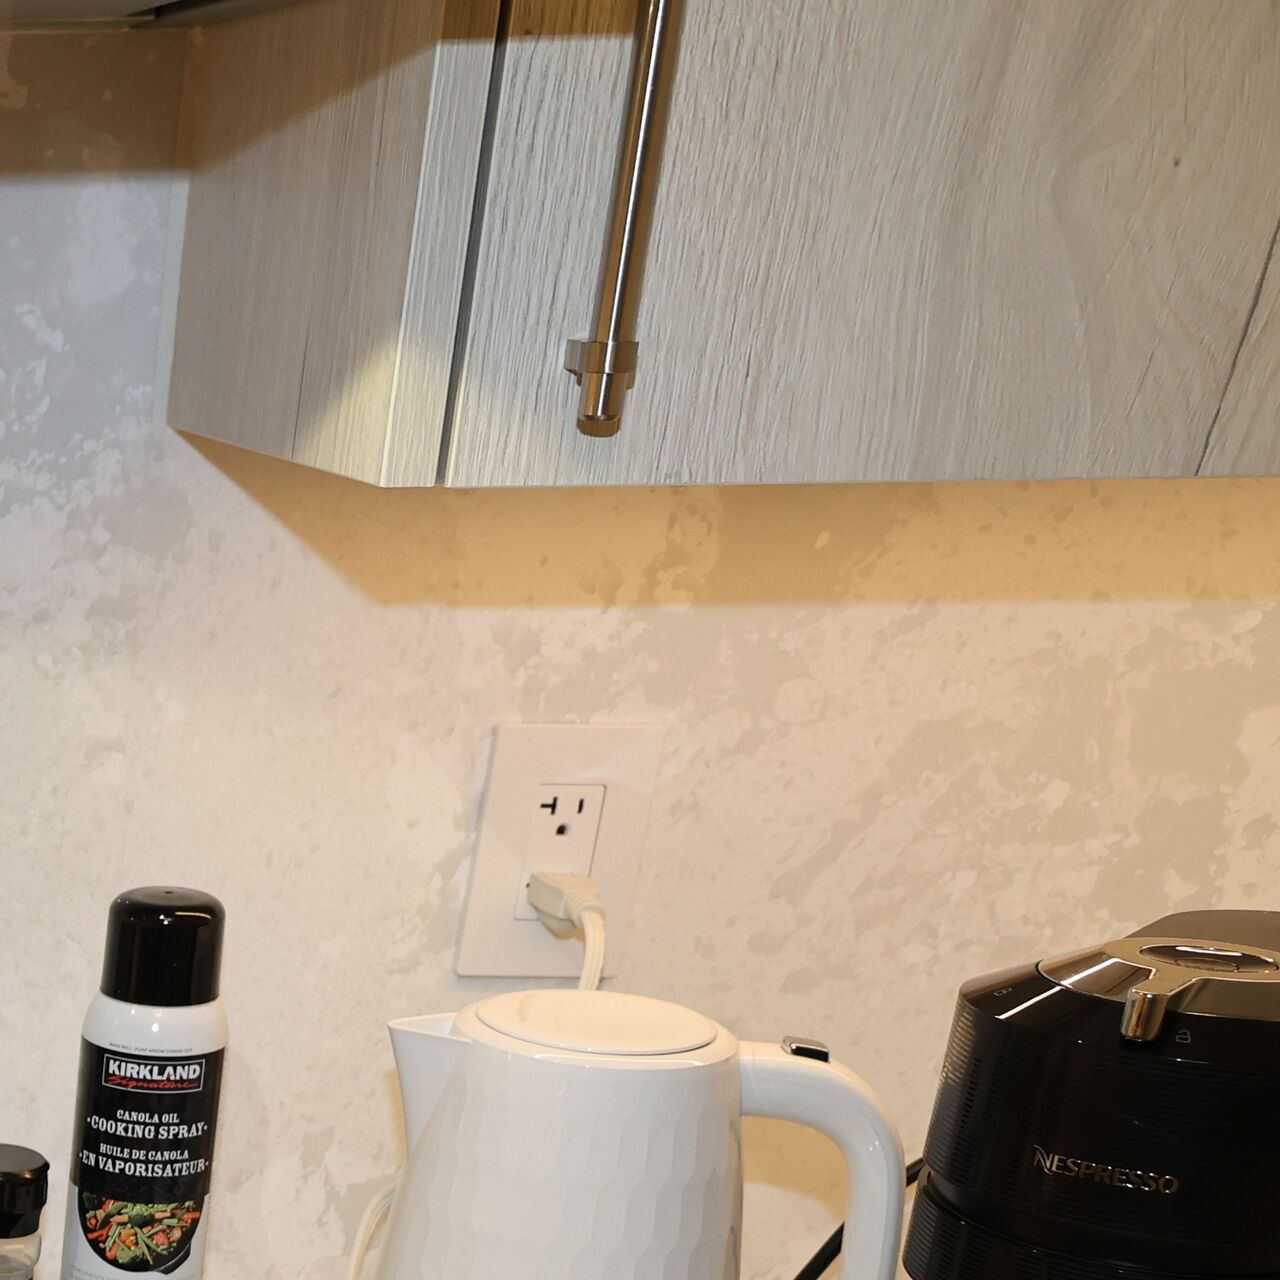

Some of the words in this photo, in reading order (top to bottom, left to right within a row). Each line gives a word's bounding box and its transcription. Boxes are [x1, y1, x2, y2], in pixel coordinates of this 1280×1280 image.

[108, 1060, 200, 1080] KIRKLAND
[108, 1076, 199, 1089] Signature
[116, 1109, 160, 1123] CANOLA
[161, 1113, 180, 1123] OIL
[91, 1115, 155, 1139] COOKING
[158, 1122, 204, 1139] SPRAY
[99, 1143, 130, 1158] HUILE
[131, 1149, 147, 1160] DE
[148, 1149, 189, 1161] CANOLA
[82, 1150, 96, 1167] EN
[98, 1155, 205, 1177] VAPORISATEUR
[1032, 1144, 1180, 1194] NESPRESSO
